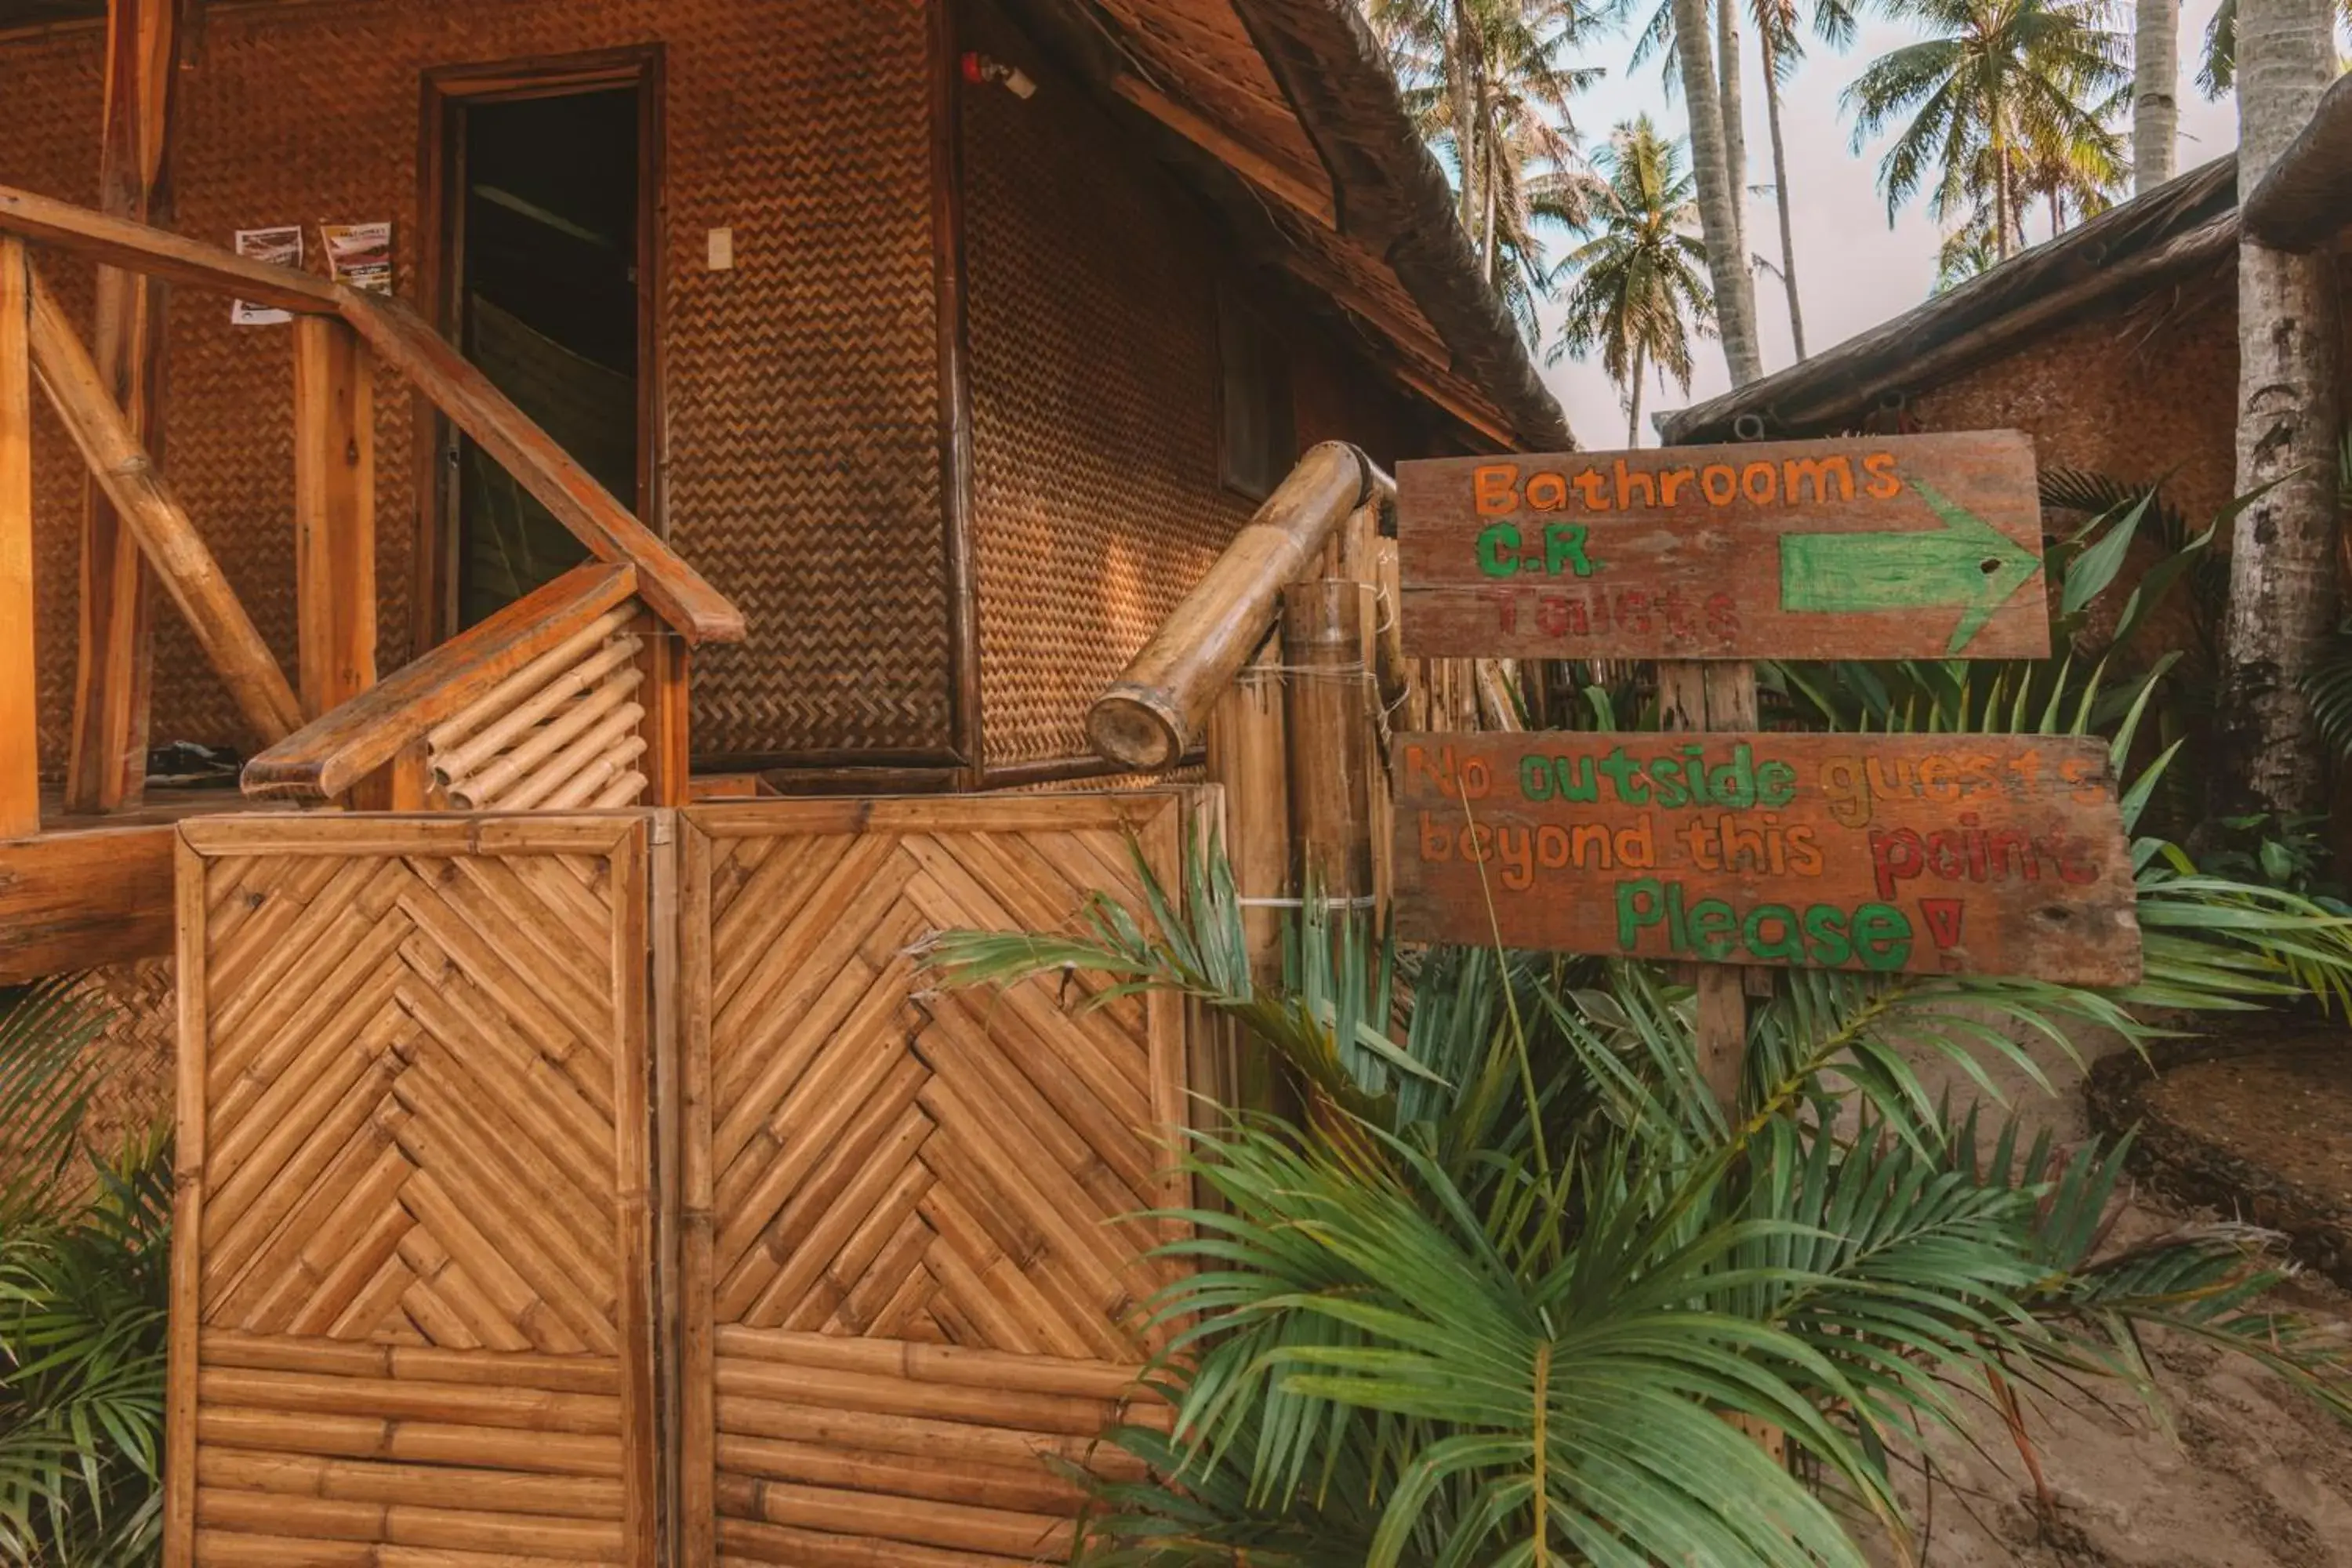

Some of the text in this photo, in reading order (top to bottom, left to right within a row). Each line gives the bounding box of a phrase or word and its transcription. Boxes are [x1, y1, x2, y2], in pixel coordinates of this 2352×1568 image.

[1473, 453, 1901, 515] Bathrooms
[1403, 742, 2107, 829] No outside guests
[1417, 811, 2100, 901] beyond this point
